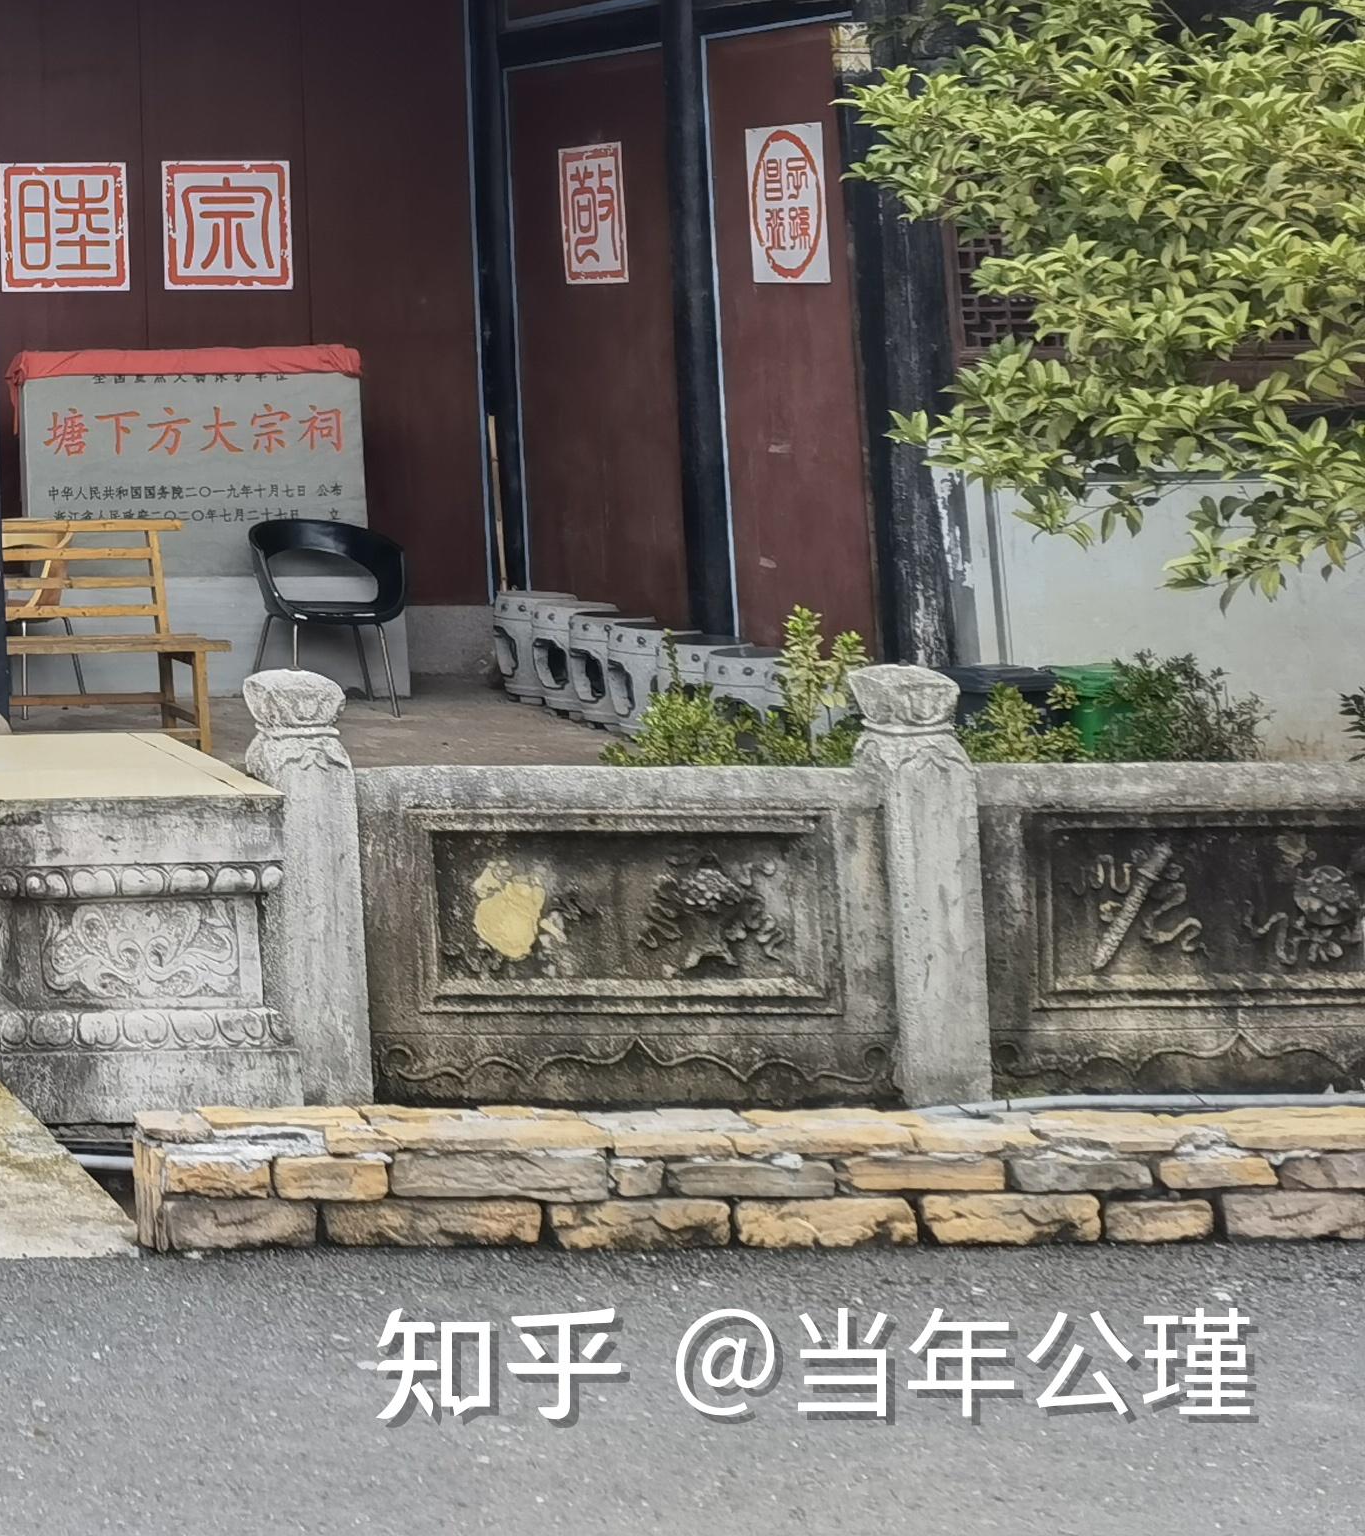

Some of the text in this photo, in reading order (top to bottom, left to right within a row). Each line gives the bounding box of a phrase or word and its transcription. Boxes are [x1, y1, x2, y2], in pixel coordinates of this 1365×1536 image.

[19, 179, 111, 271] 睦
[181, 177, 275, 270] 宗
[43, 403, 346, 457] 塘下方大宗祠
[316, 482, 343, 497] 公布
